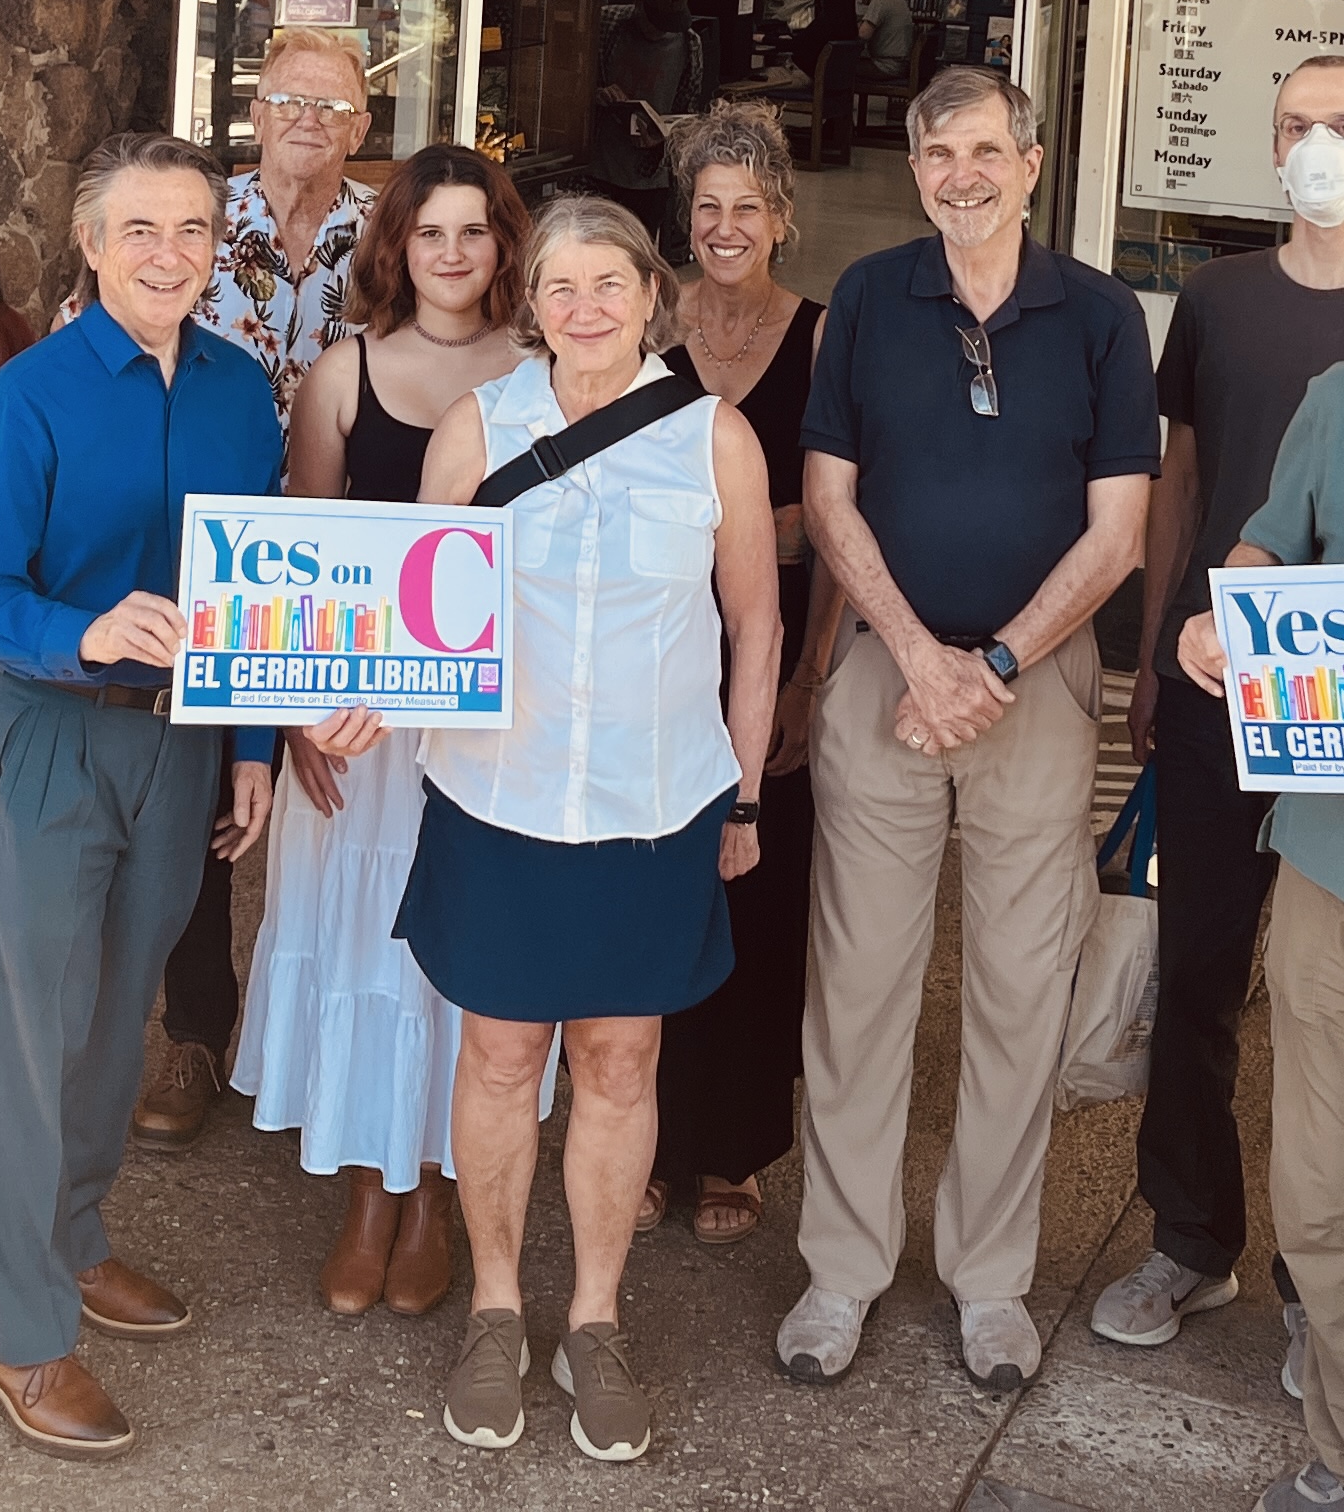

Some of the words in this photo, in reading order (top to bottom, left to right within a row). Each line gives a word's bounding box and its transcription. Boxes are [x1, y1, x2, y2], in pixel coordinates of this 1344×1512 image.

[1158, 63, 1222, 82] Saturday
[1171, 80, 1208, 92] Sabado
[1156, 106, 1208, 125] Sunday
[1169, 123, 1217, 137] Domingo
[1154, 149, 1212, 169] Monday
[1166, 166, 1196, 178] Lunes
[200, 519, 321, 586] Yes
[331, 564, 374, 585] on
[398, 527, 495, 653] C
[187, 655, 221, 689] EL
[229, 656, 350, 691] CERRITO
[358, 658, 476, 693] LIBRARY
[233, 693, 255, 703] Paid
[258, 693, 271, 703] for
[274, 693, 285, 705] by
[288, 694, 305, 704] Yes
[308, 696, 320, 704] on
[335, 694, 368, 705] Cerrito
[370, 696, 402, 708] Library
[405, 696, 446, 706] Measure
[449, 697, 457, 706] C
[1244, 725, 1281, 758] EL
[1295, 762, 1317, 772] Paid
[1320, 762, 1332, 772] for
